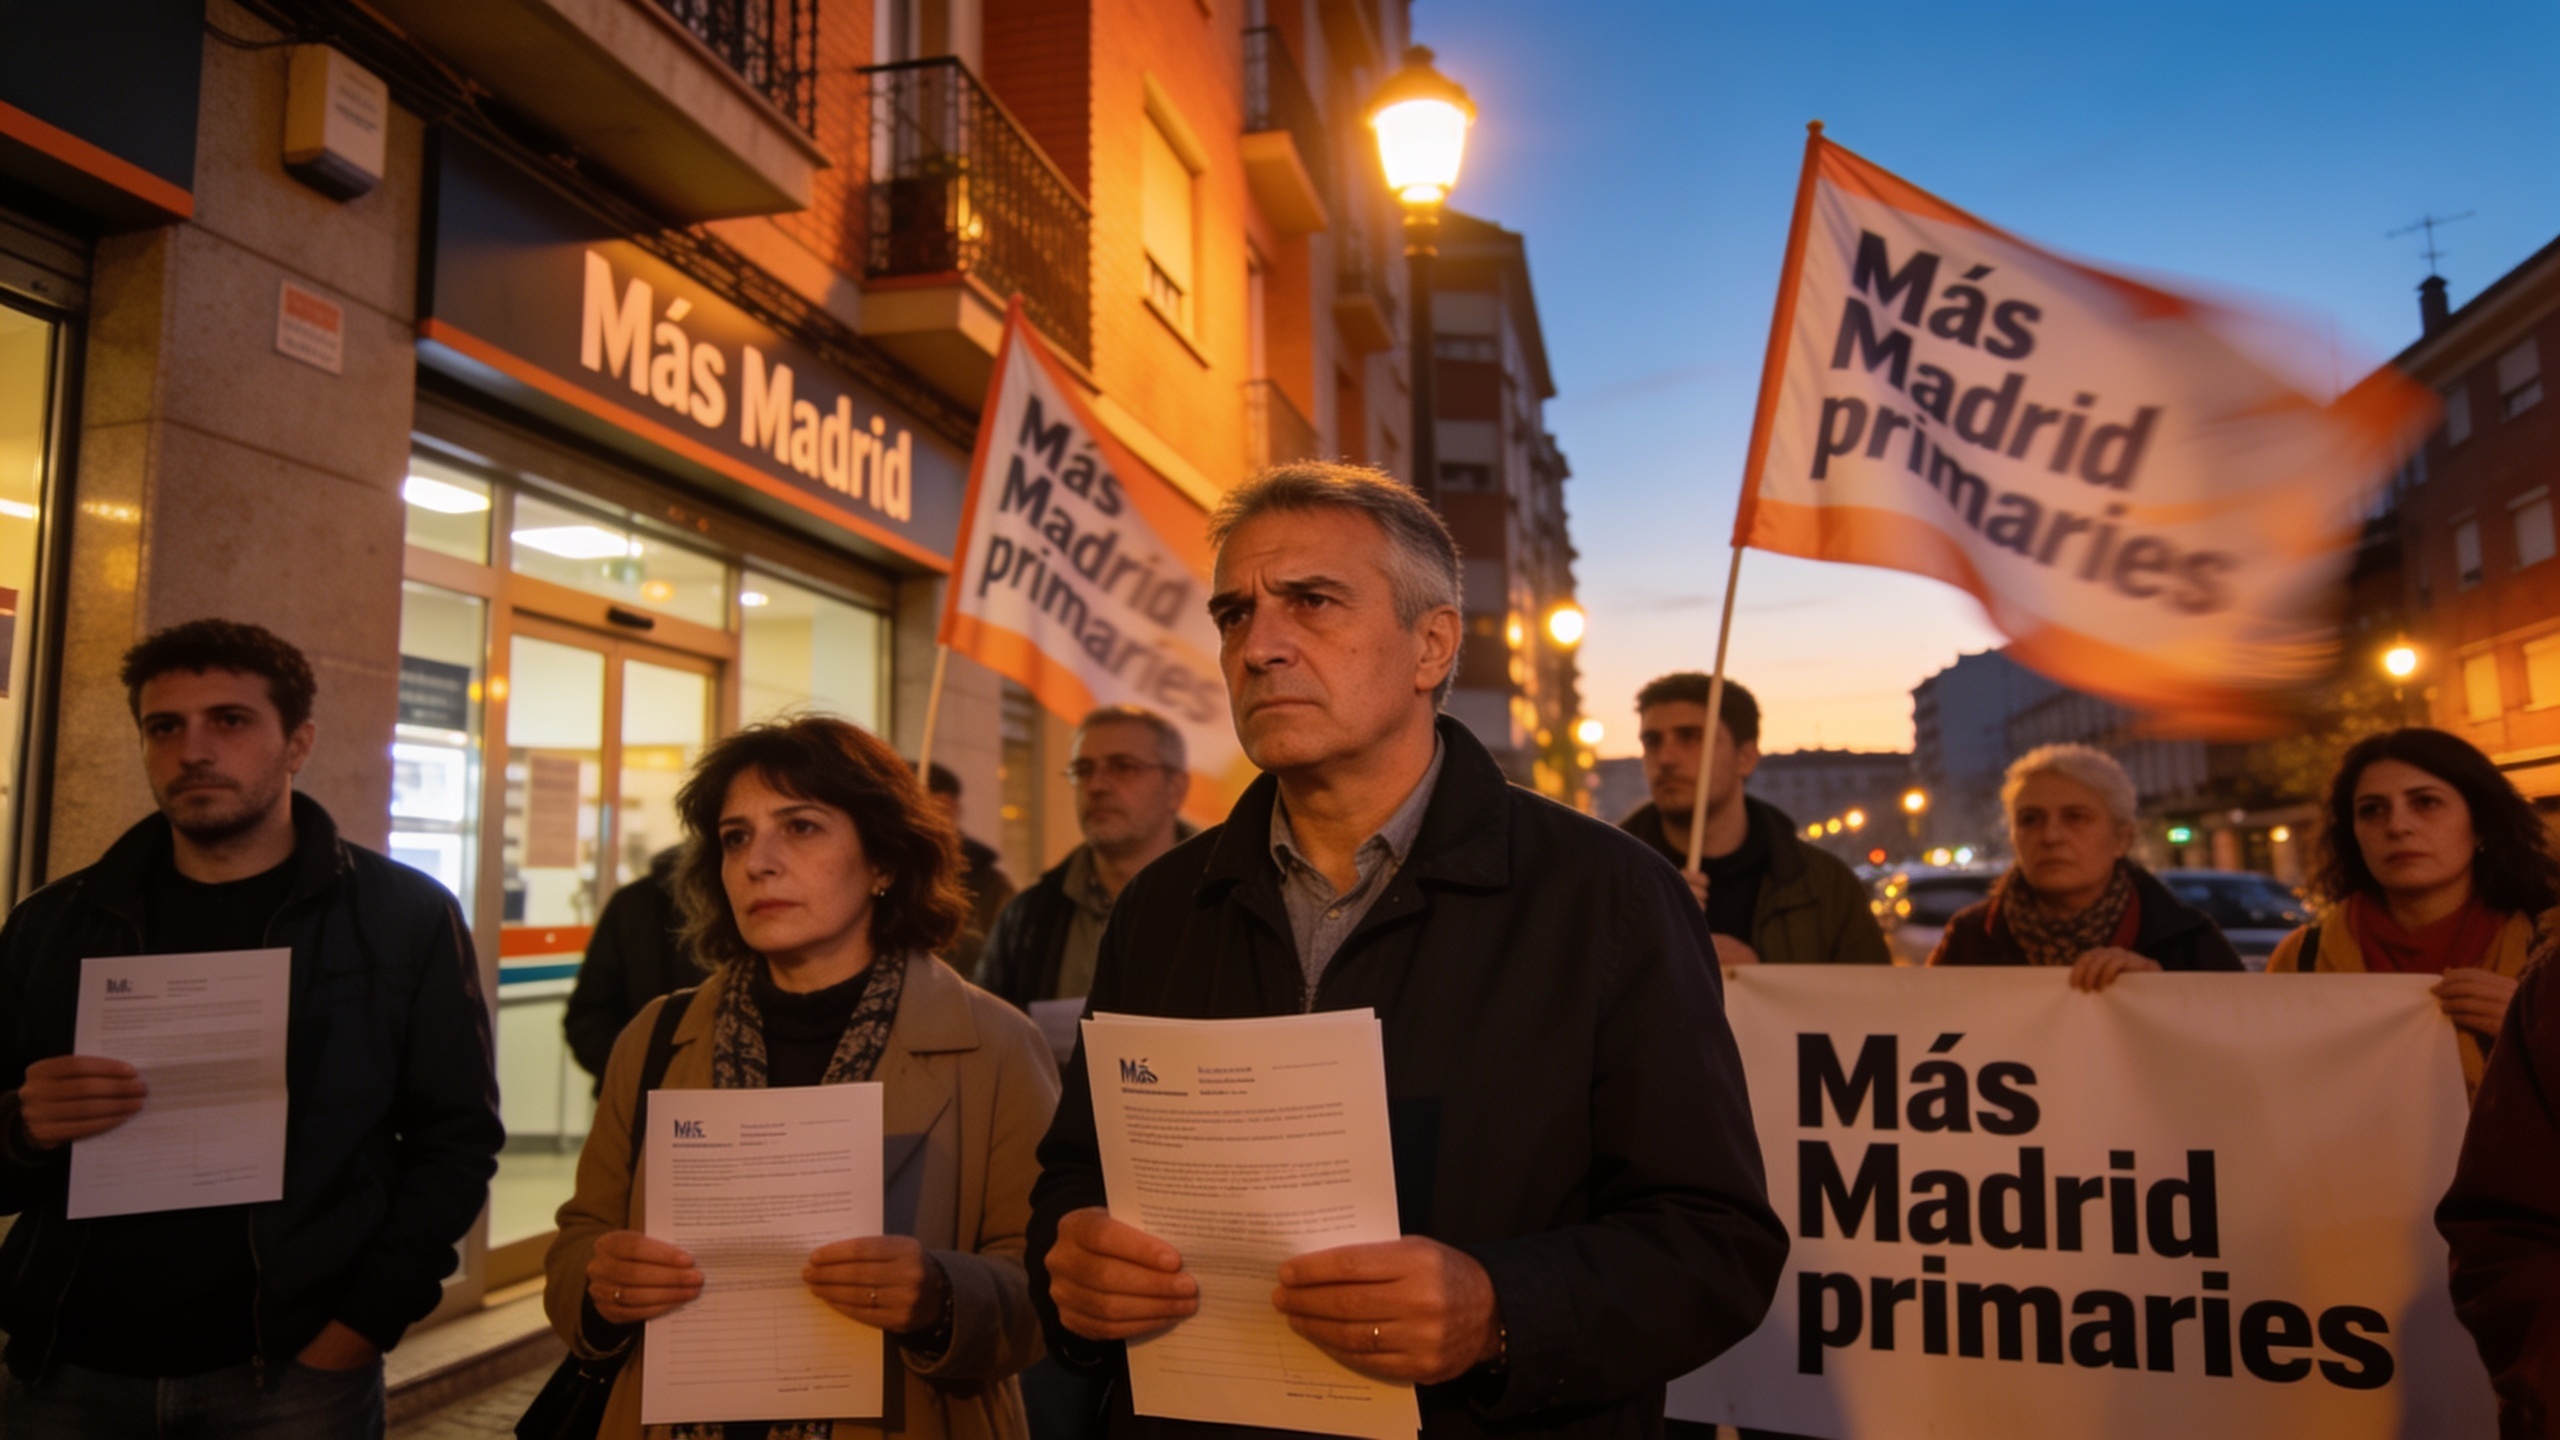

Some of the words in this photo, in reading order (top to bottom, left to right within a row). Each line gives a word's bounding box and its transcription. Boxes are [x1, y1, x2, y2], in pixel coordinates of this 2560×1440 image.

[1852, 228, 2042, 360] Más
[580, 249, 727, 428] Más
[740, 344, 912, 523] Madrid
[1018, 392, 1126, 518] Más
[1830, 296, 2163, 492] Madrid
[998, 453, 1193, 629] Madrid
[1810, 394, 2241, 616] primaries
[977, 535, 1225, 725] primaries
[1796, 1032, 2041, 1136] Más
[1796, 1139, 2221, 1259] Madrid
[1796, 1254, 2396, 1391] primaries
